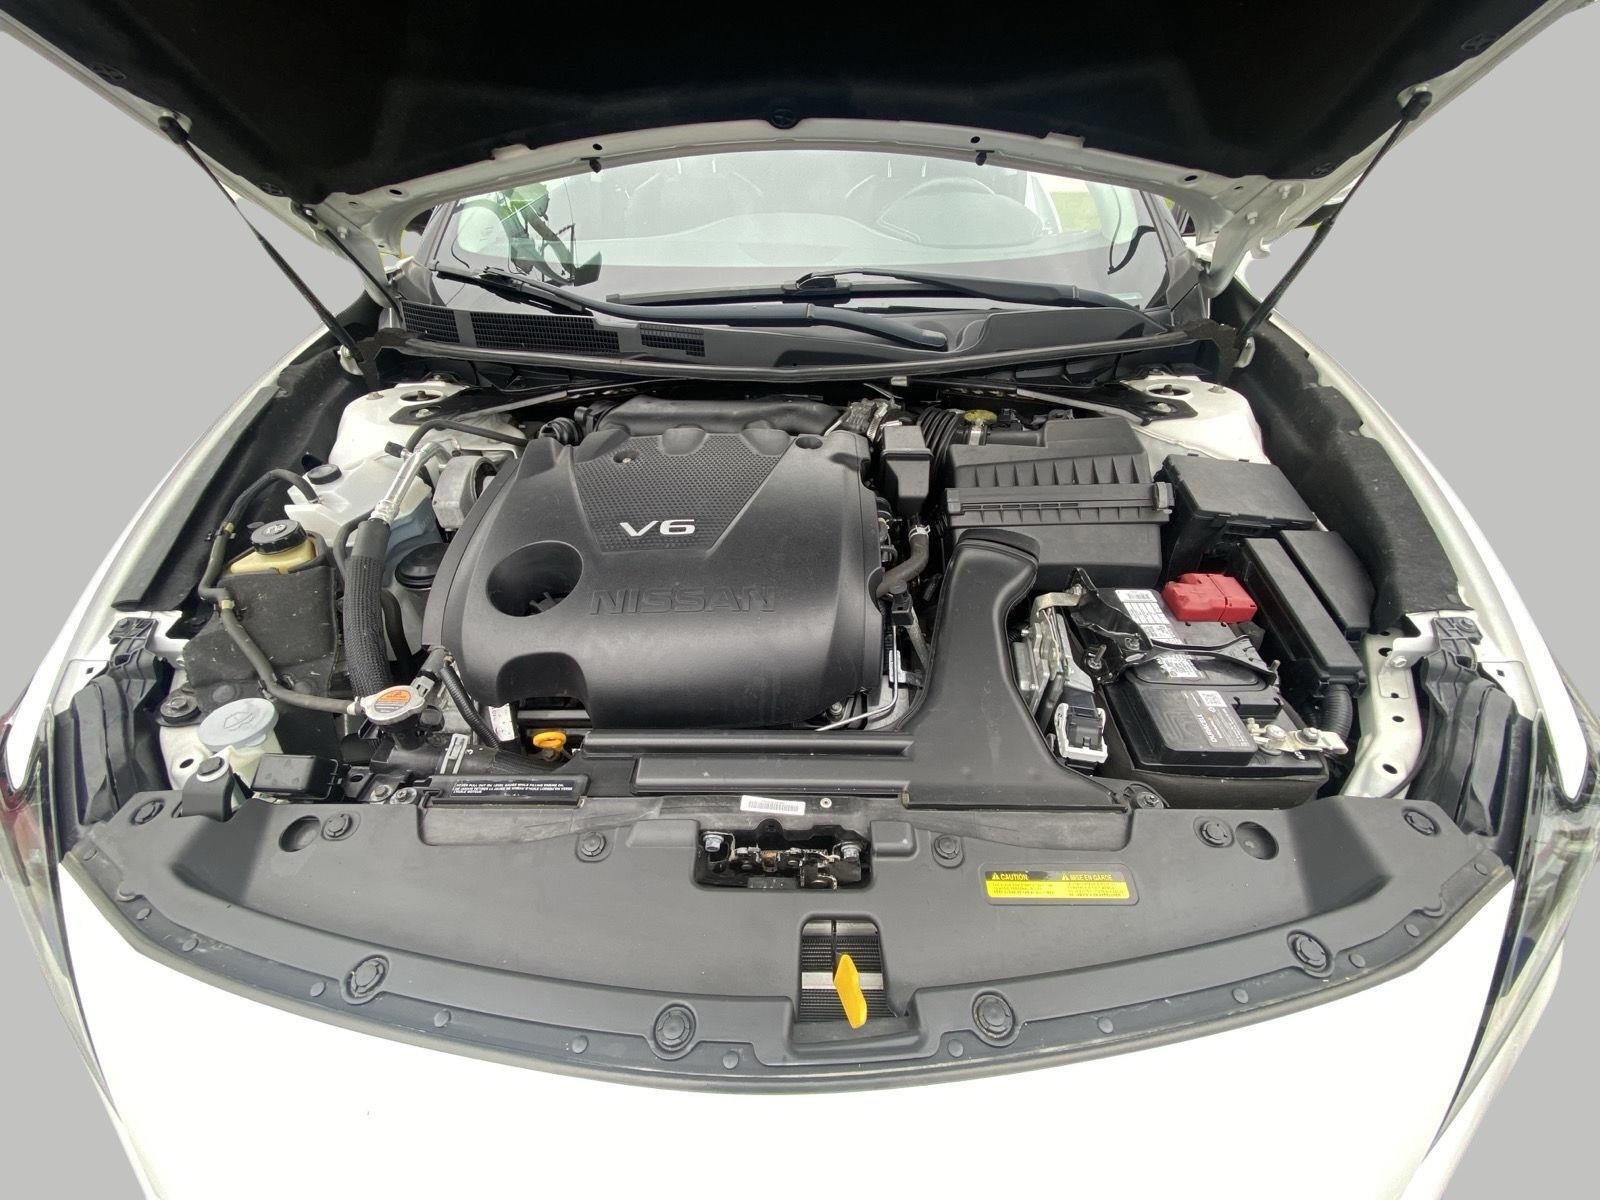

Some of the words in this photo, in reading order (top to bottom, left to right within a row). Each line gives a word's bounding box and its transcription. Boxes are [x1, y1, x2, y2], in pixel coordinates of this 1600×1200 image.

[620, 519, 696, 537] V6
[590, 586, 776, 616] NISSAN
[1000, 873, 1029, 881] CAUTION
